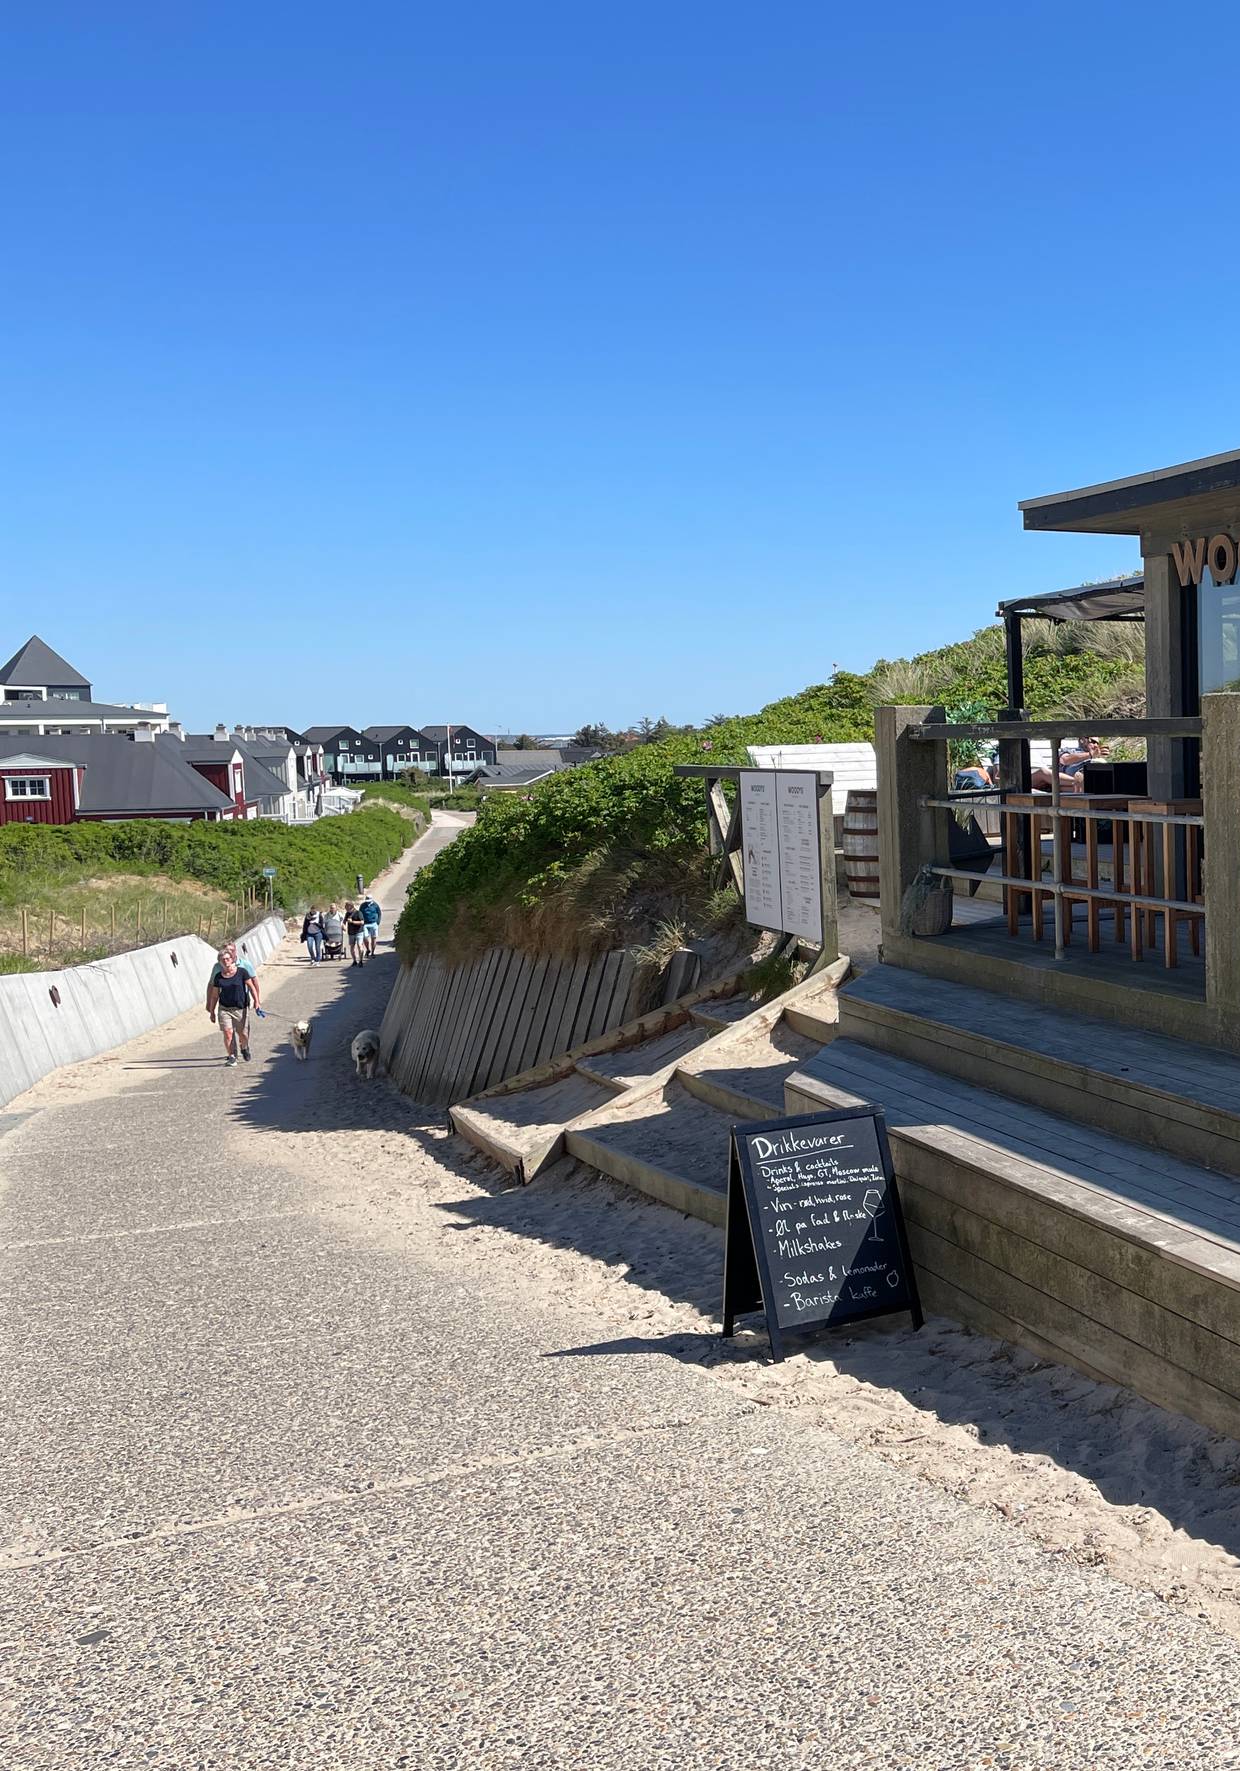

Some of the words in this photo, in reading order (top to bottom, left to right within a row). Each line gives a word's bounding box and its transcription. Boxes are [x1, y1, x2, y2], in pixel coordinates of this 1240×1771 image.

[751, 1132, 845, 1159] Drikkevarer
[761, 1165, 793, 1178] Drinks
[805, 1158, 839, 1170] cocktails
[832, 1166, 860, 1176] Moscow
[811, 1213, 831, 1227] fad
[778, 1236, 842, 1258] Milkshakes
[784, 1271, 825, 1287] Sodas
[829, 1266, 837, 1280] &
[790, 1291, 841, 1311] Barista
[849, 1286, 878, 1300] kaffe
